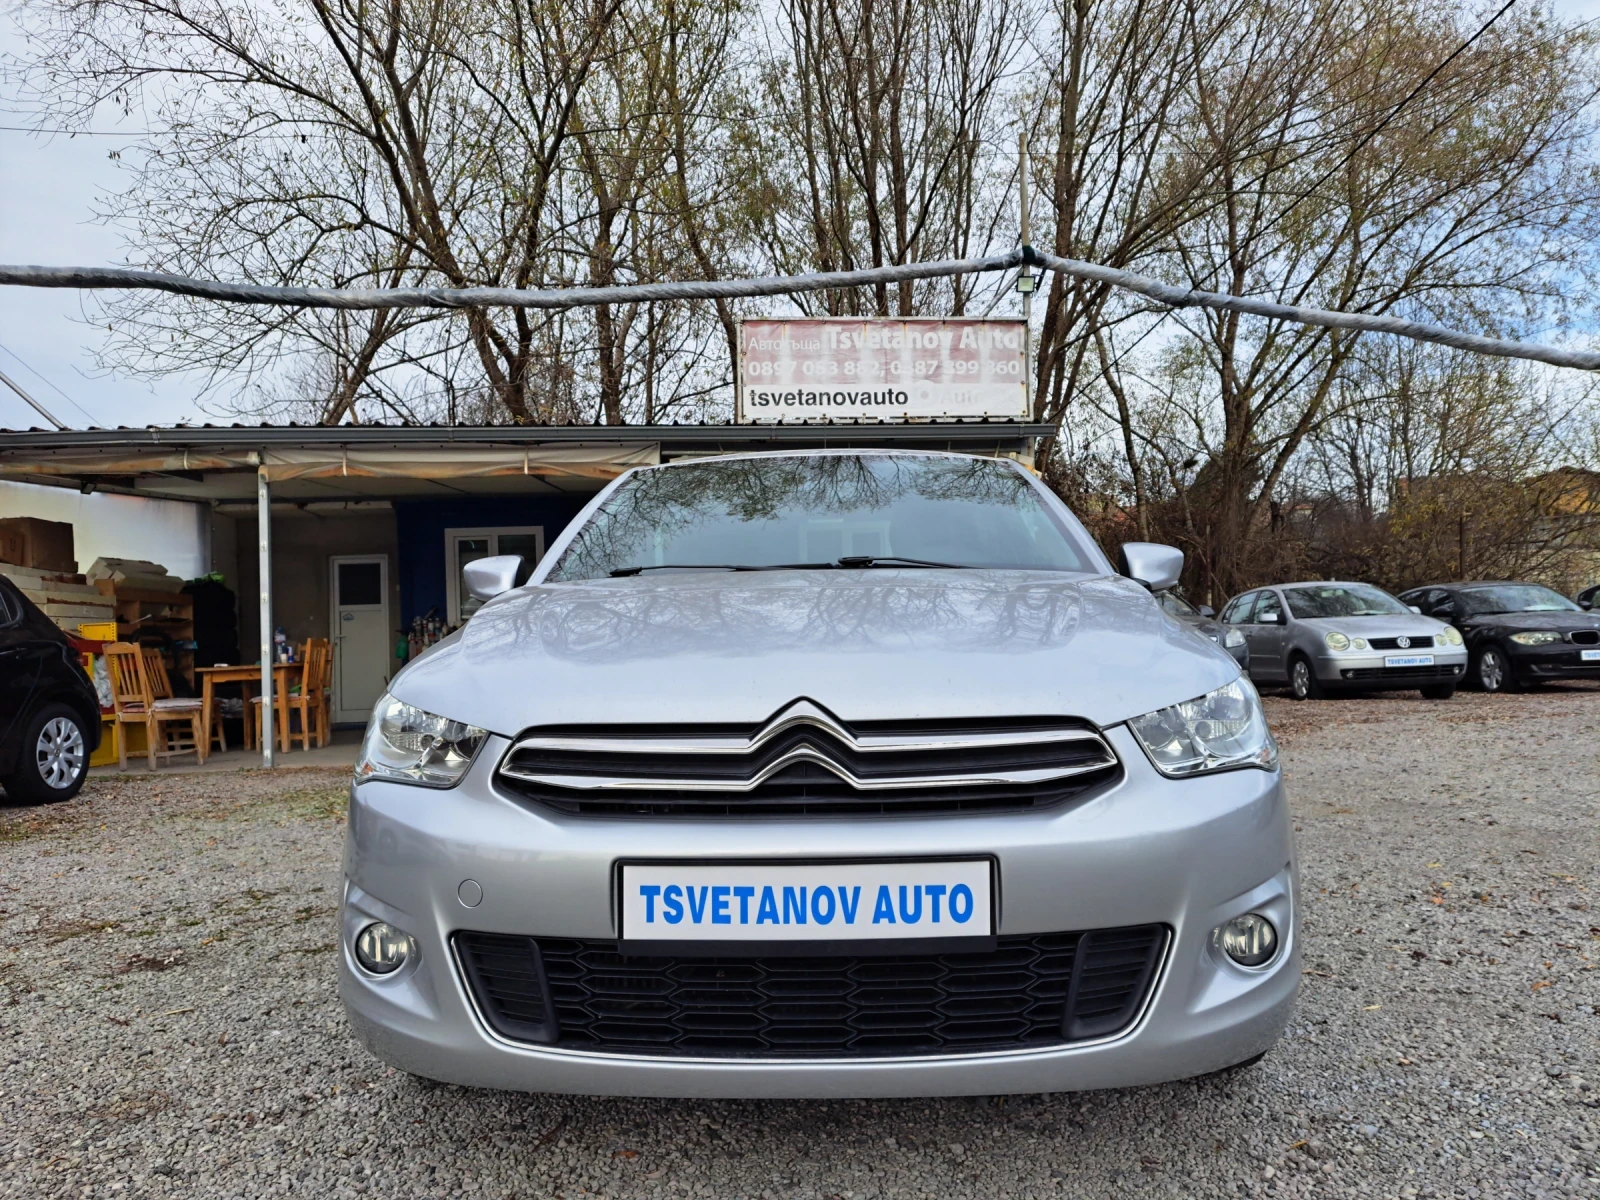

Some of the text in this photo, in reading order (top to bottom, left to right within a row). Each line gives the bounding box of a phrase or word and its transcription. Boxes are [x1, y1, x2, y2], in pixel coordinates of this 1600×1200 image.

[748, 337, 820, 352] Автоъща
[827, 326, 1018, 349] Tsvetanov Auto
[751, 388, 909, 406] tsvetanovauto
[640, 883, 973, 925] TSVETANOV AUTO
